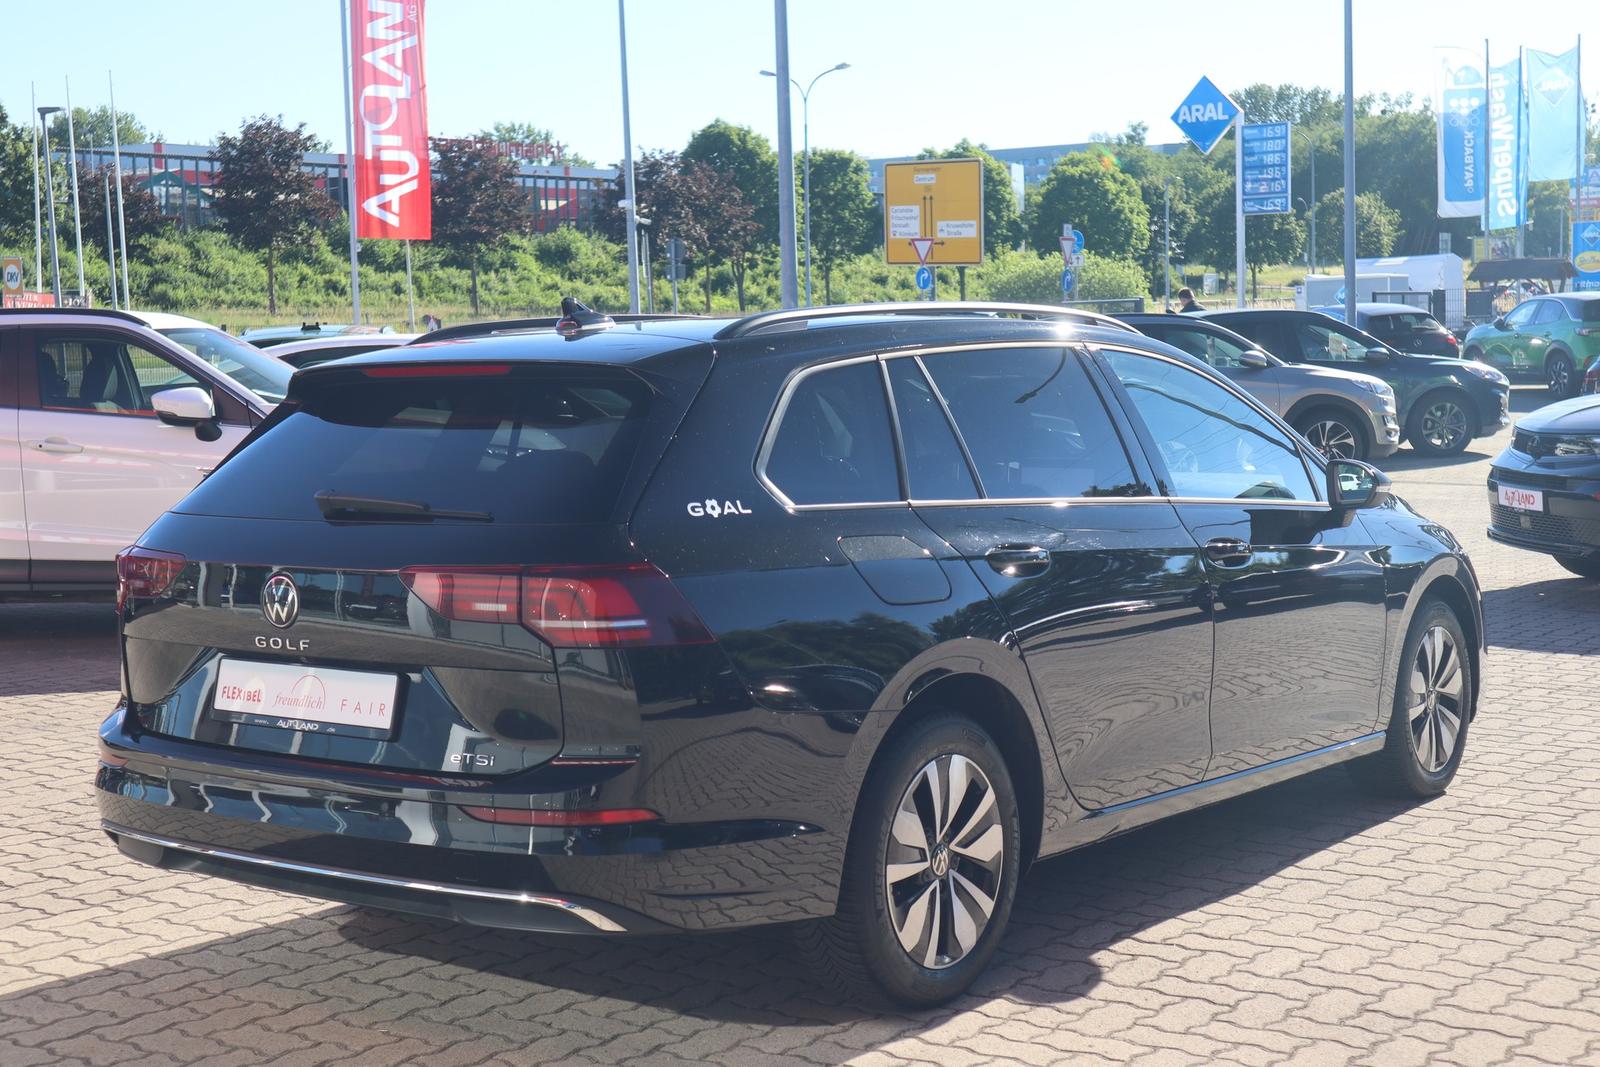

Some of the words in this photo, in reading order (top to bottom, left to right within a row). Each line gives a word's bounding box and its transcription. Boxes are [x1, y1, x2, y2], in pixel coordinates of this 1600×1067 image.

[359, 0, 420, 228] AUTOLAN
[1178, 102, 1229, 123] ARAL
[6, 271, 19, 283] DKV
[687, 499, 752, 518] GOAL
[255, 636, 310, 651] GOLF
[272, 691, 324, 710] freundlich
[340, 698, 386, 717] FAIR
[276, 718, 319, 732] AUTOLAND
